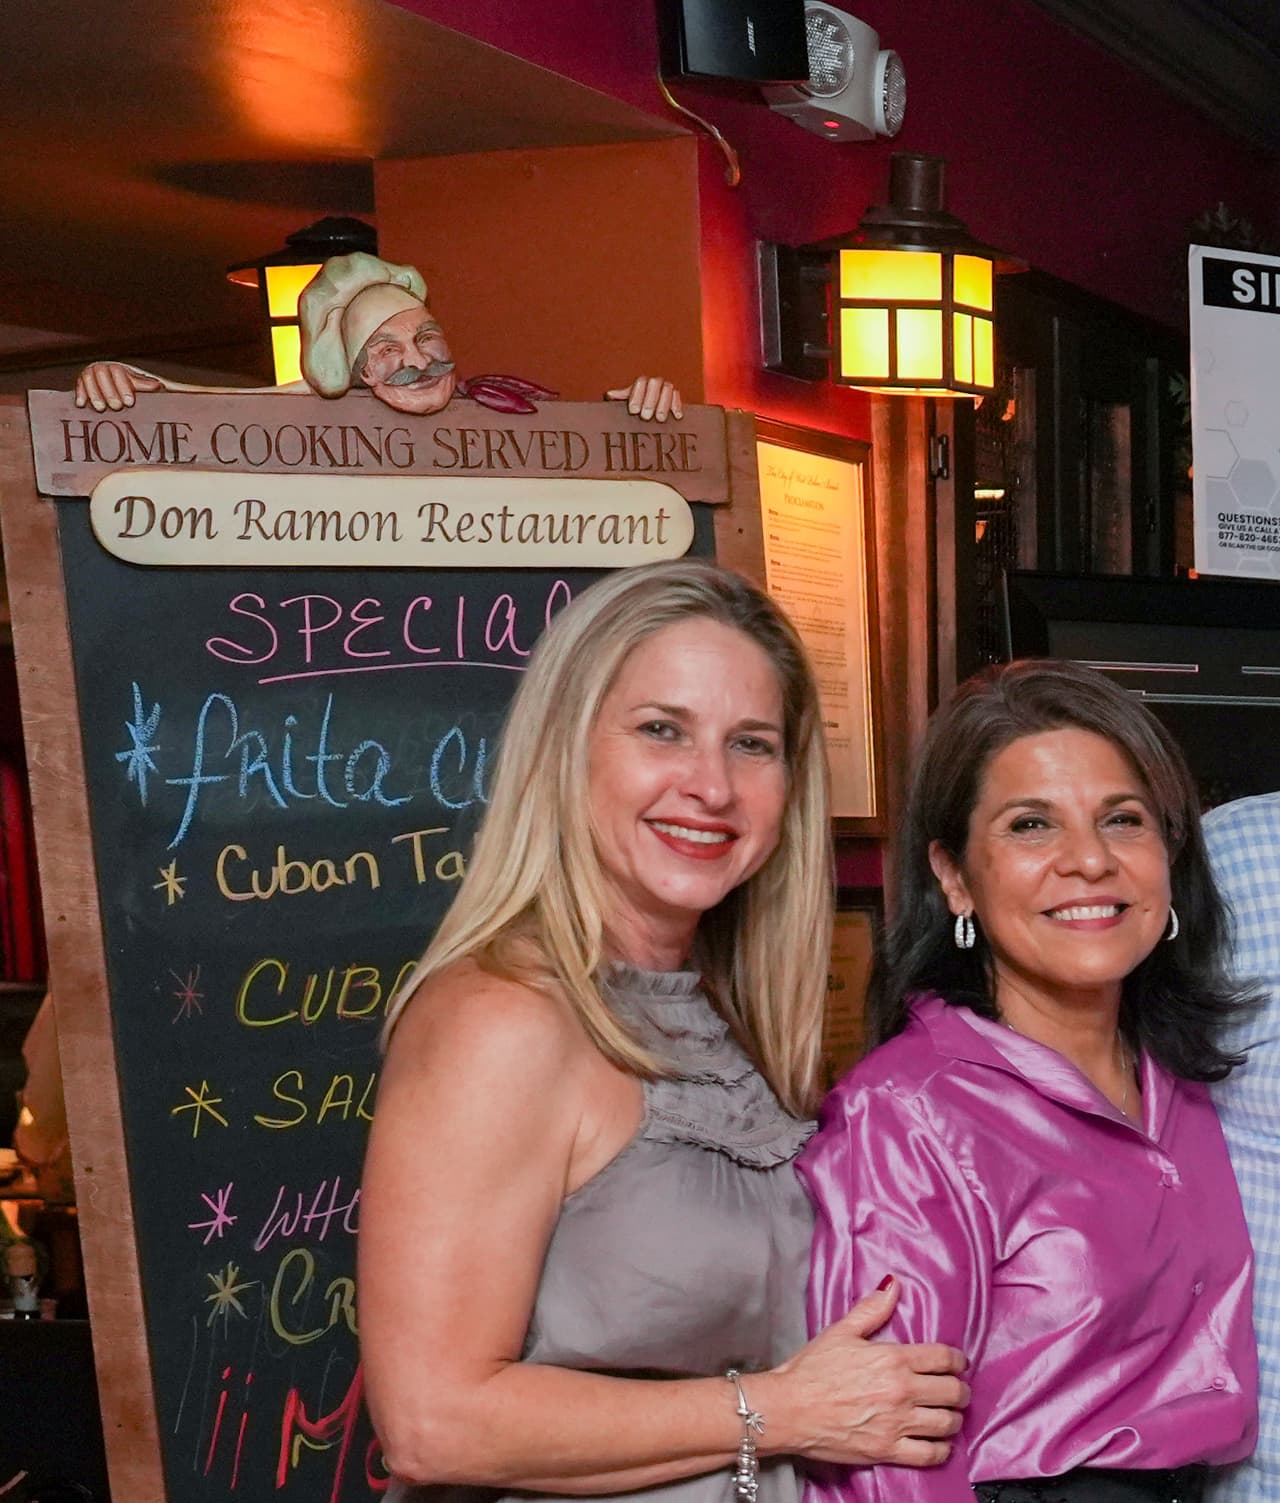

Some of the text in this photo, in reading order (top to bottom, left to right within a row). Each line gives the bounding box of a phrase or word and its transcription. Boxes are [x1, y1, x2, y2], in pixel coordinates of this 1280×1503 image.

[60, 419, 702, 473] HOME COOKING SERVED HERE
[113, 495, 672, 545] Don Ramon Restaurant
[1218, 523, 1234, 531] GIVE
[1236, 524, 1247, 532] US
[1254, 526, 1272, 534] CALL
[216, 844, 380, 901] Cuban
